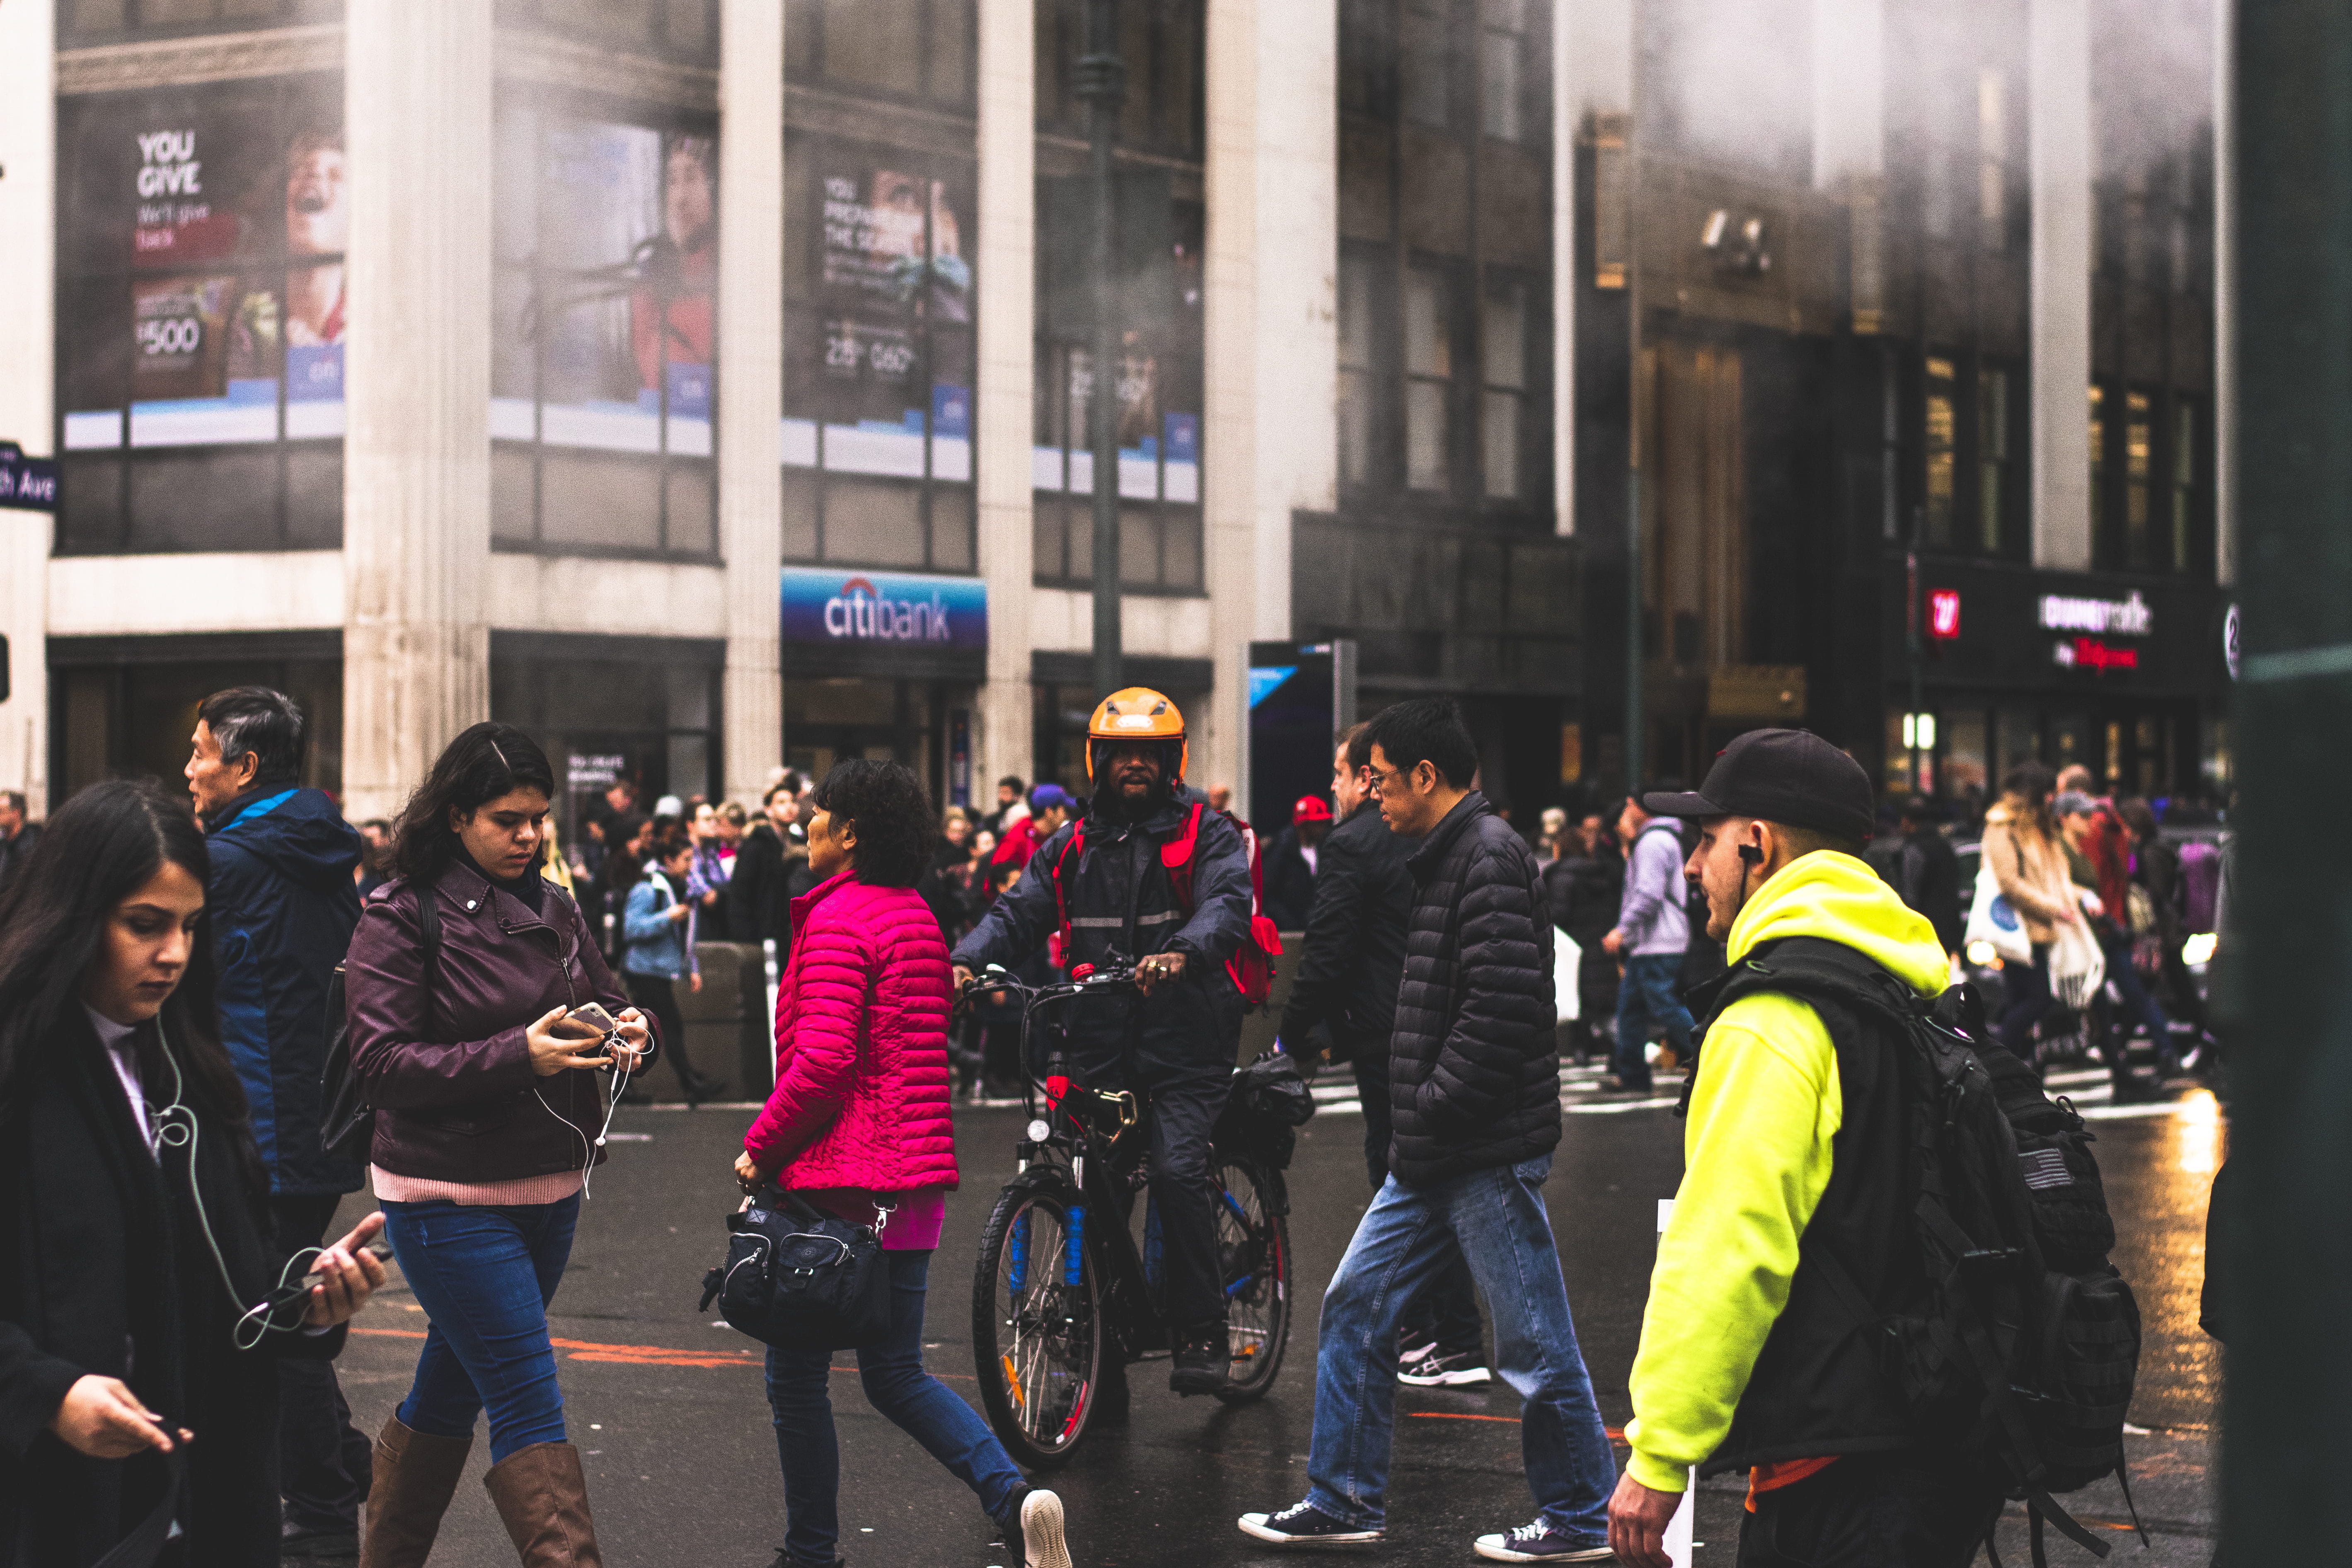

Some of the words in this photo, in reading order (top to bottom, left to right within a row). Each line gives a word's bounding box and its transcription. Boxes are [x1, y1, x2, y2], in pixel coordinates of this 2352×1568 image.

[138, 130, 195, 162] YOU
[138, 162, 202, 197] GIVE
[19, 469, 55, 500] Ave
[825, 585, 951, 640] citibank
